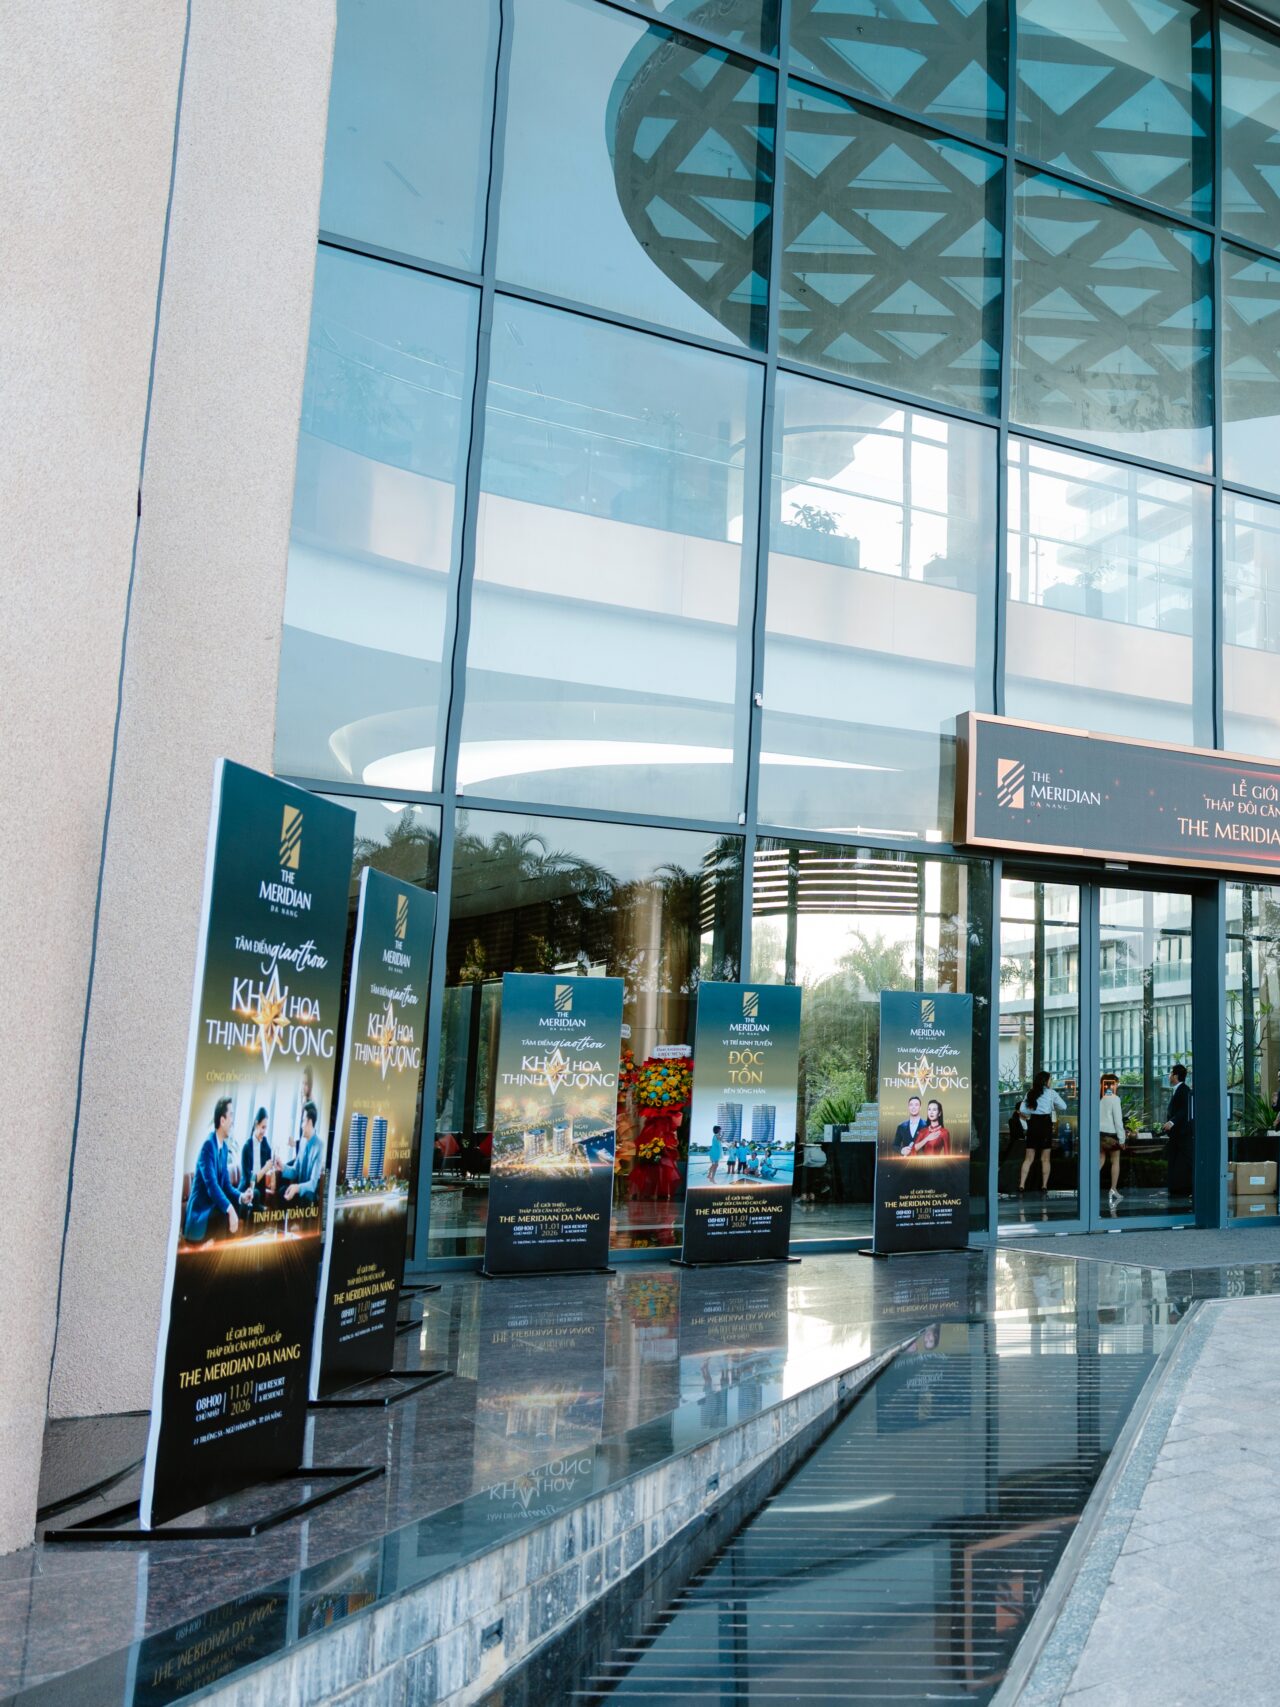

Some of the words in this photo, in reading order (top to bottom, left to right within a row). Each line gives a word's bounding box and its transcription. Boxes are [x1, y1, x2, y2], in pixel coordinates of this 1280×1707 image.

[1032, 771, 1050, 783] THE
[1030, 784, 1101, 806] MERIDIAN
[1232, 778, 1248, 797] LỄ
[1252, 784, 1278, 801] GIỚI
[1205, 797, 1234, 812] THÁP
[1238, 800, 1257, 815] ĐÔI
[1177, 817, 1209, 838] THE
[281, 869, 295, 885] THE
[259, 880, 312, 911] MERIDIAN
[270, 904, 279, 913] DA
[281, 907, 298, 918] NANG
[235, 935, 252, 952] TÂM
[253, 938, 272, 957] ĐIỂM
[382, 949, 411, 969] MERIDIAN
[290, 995, 320, 1021] HOA
[539, 1018, 586, 1028] MERIDIAN
[729, 1024, 770, 1032] MERIDIAN
[910, 1028, 945, 1036] MERIDIAN
[206, 1019, 256, 1051] THỊNH
[398, 1024, 414, 1042] HOA
[573, 1061, 602, 1072] HOA
[728, 1048, 764, 1068] ĐỘC
[501, 1073, 543, 1086] THỊNH
[728, 1067, 763, 1084] TÔN
[936, 1066, 958, 1075] HOA
[883, 1077, 915, 1088] THỊNH
[942, 1198, 962, 1206] NANG
[253, 1211, 270, 1223] TINH
[270, 1209, 285, 1221] HOA
[287, 1205, 304, 1219] TOÀN
[304, 1202, 319, 1218] CẦU
[499, 1215, 516, 1223] THE
[517, 1214, 559, 1222] MERIDIAN
[575, 1213, 600, 1221] NANG
[695, 1208, 710, 1216] THE
[711, 1207, 748, 1215] MERIDIAN
[333, 1292, 345, 1306] THE
[345, 1286, 371, 1303] MERIDIAN
[380, 1279, 396, 1293] NANG
[226, 1326, 234, 1341] LỄ
[248, 1322, 265, 1336] THIỆU
[206, 1345, 223, 1359] THÁP
[258, 1335, 271, 1347] CAO
[271, 1329, 282, 1344] CẤP
[180, 1367, 202, 1389] THE
[204, 1355, 255, 1382] MERIDIAN
[257, 1352, 271, 1368] DA
[273, 1343, 301, 1364] NANG
[230, 1380, 254, 1400] 11.01
[267, 1376, 286, 1390] RESORT
[196, 1393, 222, 1412] 08H00
[230, 1399, 251, 1416] 2026
